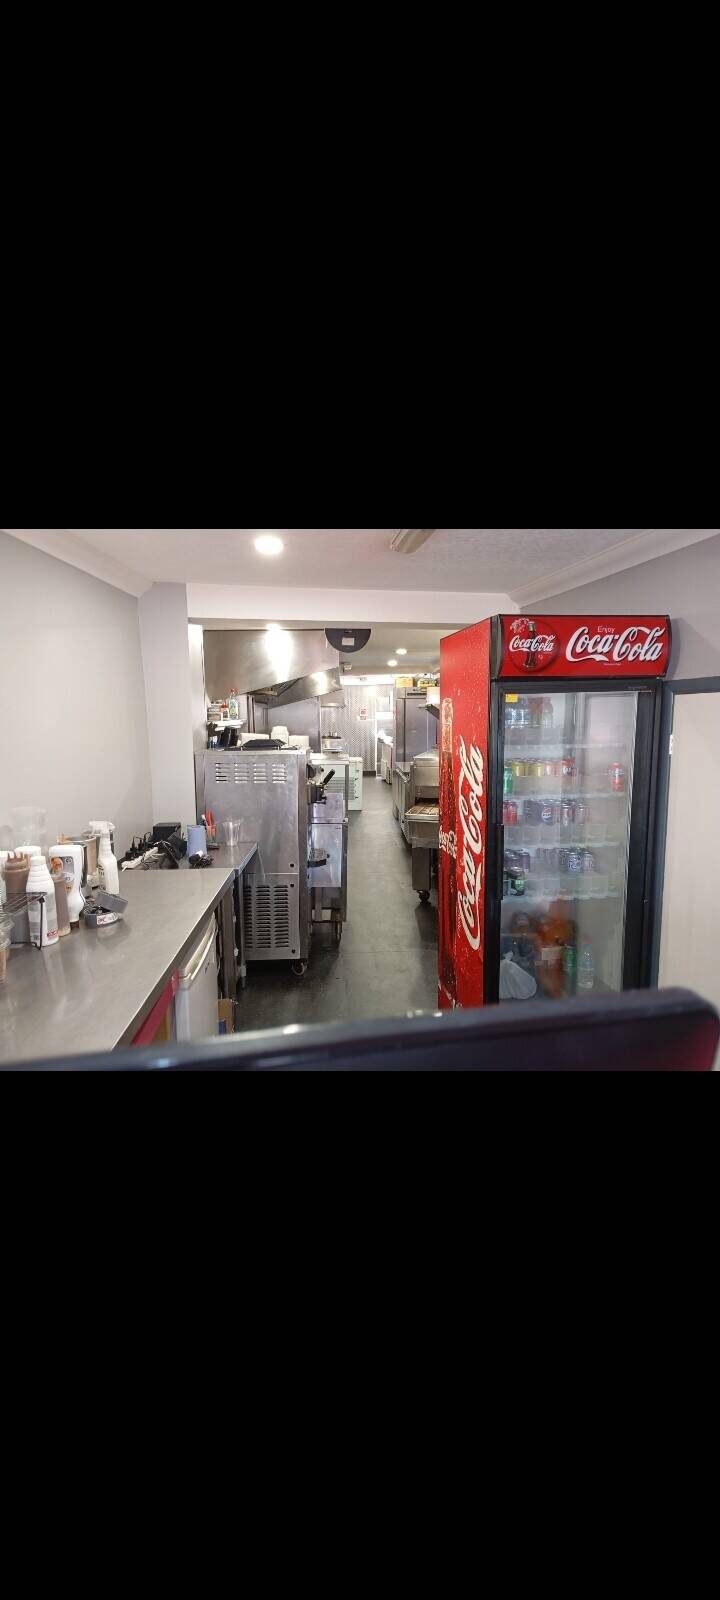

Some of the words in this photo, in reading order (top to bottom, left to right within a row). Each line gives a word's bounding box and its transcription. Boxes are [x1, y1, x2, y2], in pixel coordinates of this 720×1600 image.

[597, 625, 614, 634] Enjoy
[509, 635, 555, 652] Coca-Cola
[566, 626, 665, 662] Coca-Cola
